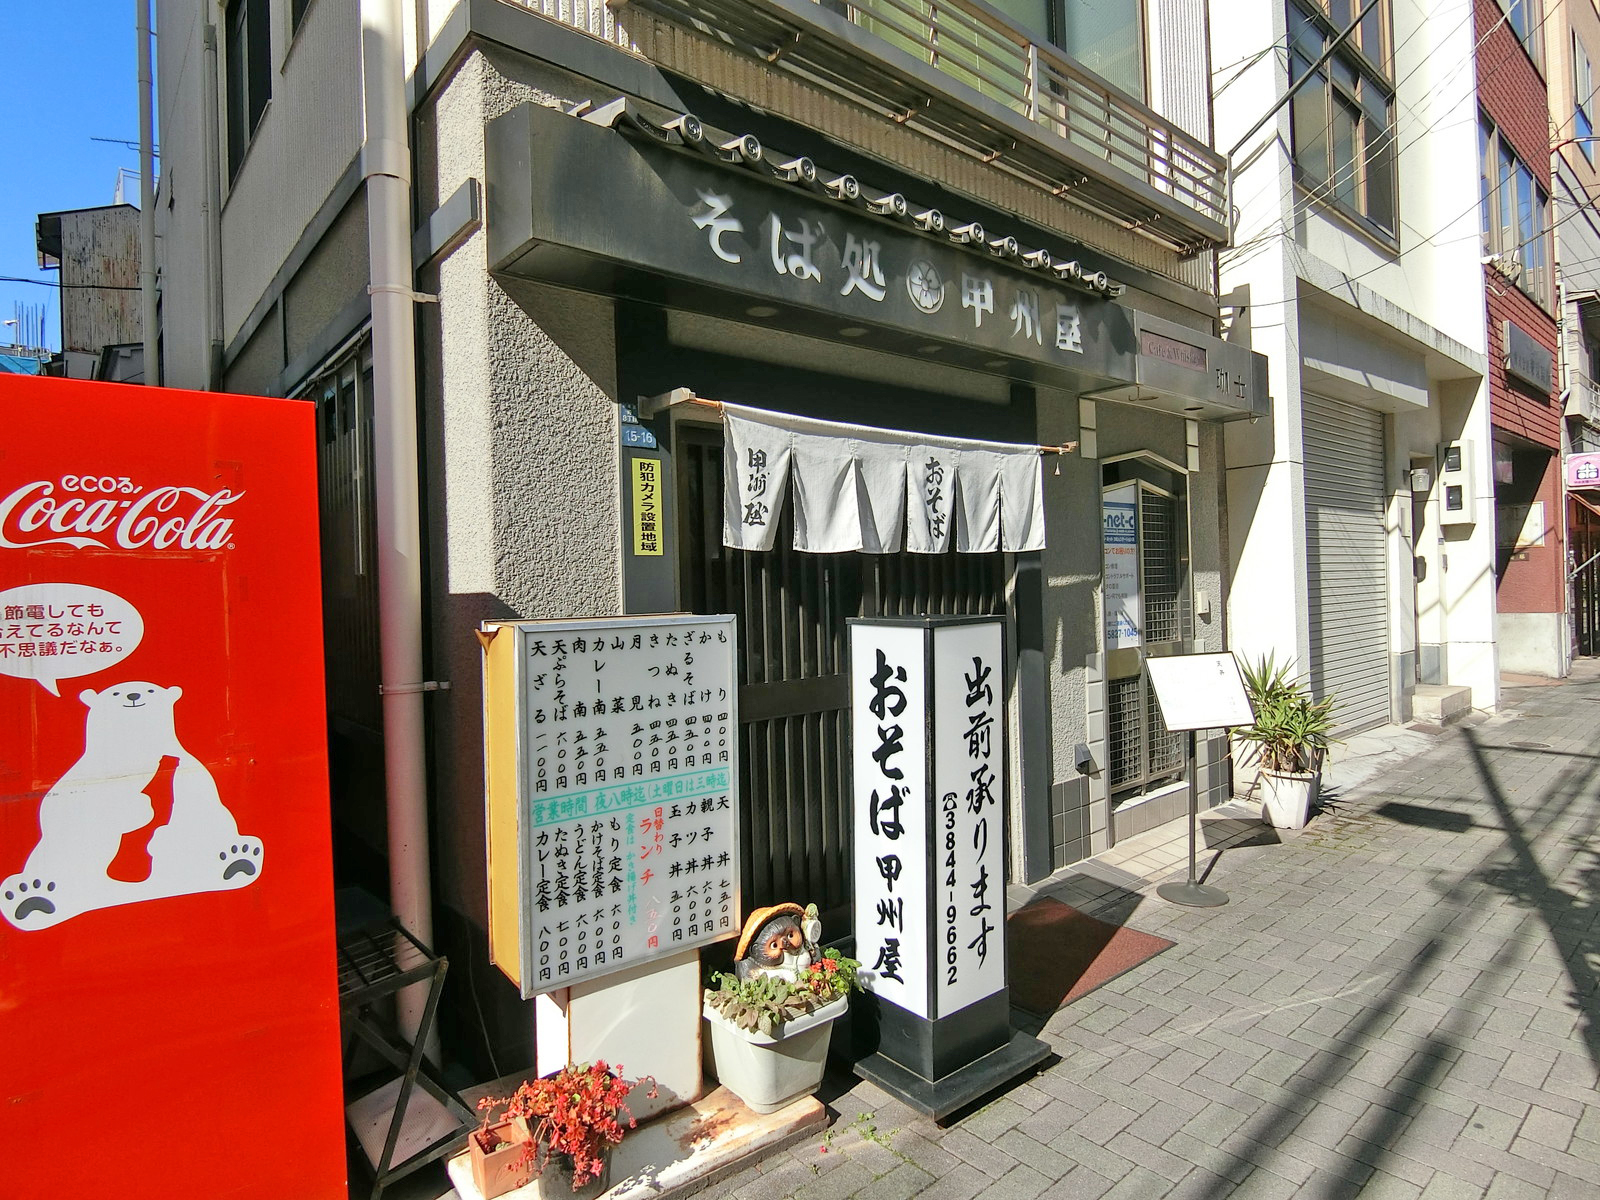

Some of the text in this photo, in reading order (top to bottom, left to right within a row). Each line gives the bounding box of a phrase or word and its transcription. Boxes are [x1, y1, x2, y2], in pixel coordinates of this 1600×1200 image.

[690, 187, 1086, 353] そば処 甲州屋
[626, 430, 652, 443] 15-16
[0, 480, 247, 550] Coca-Cola
[640, 462, 657, 551] 防犯カメラ設置地域
[925, 456, 946, 540] おそば
[0, 639, 123, 658] 不思議だなぁ。
[4, 603, 104, 620] 節電しても
[531, 640, 548, 723] 天ざる
[551, 639, 568, 722] 天ぷらそば
[572, 636, 587, 718] 肉南
[592, 637, 606, 715] カレー南
[610, 636, 626, 714] 山菜
[628, 634, 644, 711] 月見
[647, 633, 662, 709] きつね
[665, 632, 679, 707] たぬき
[682, 630, 697, 706] ざるそば
[699, 631, 712, 703] かけ
[717, 630, 727, 702] もり
[532, 795, 588, 823] 営業時間
[653, 806, 665, 856] 日替わり
[668, 804, 683, 879] 玉子丼
[684, 801, 699, 875] カツ丼
[700, 798, 715, 871] 親子丼
[716, 795, 731, 867] 天丼
[963, 656, 997, 970] 出前承ります
[535, 831, 552, 912] カレー定食
[554, 828, 571, 907] たぬき定食
[572, 823, 589, 903] うどん定食
[591, 820, 606, 898] かけそば定食
[607, 817, 623, 894] もり定食
[640, 817, 654, 886] ランチ
